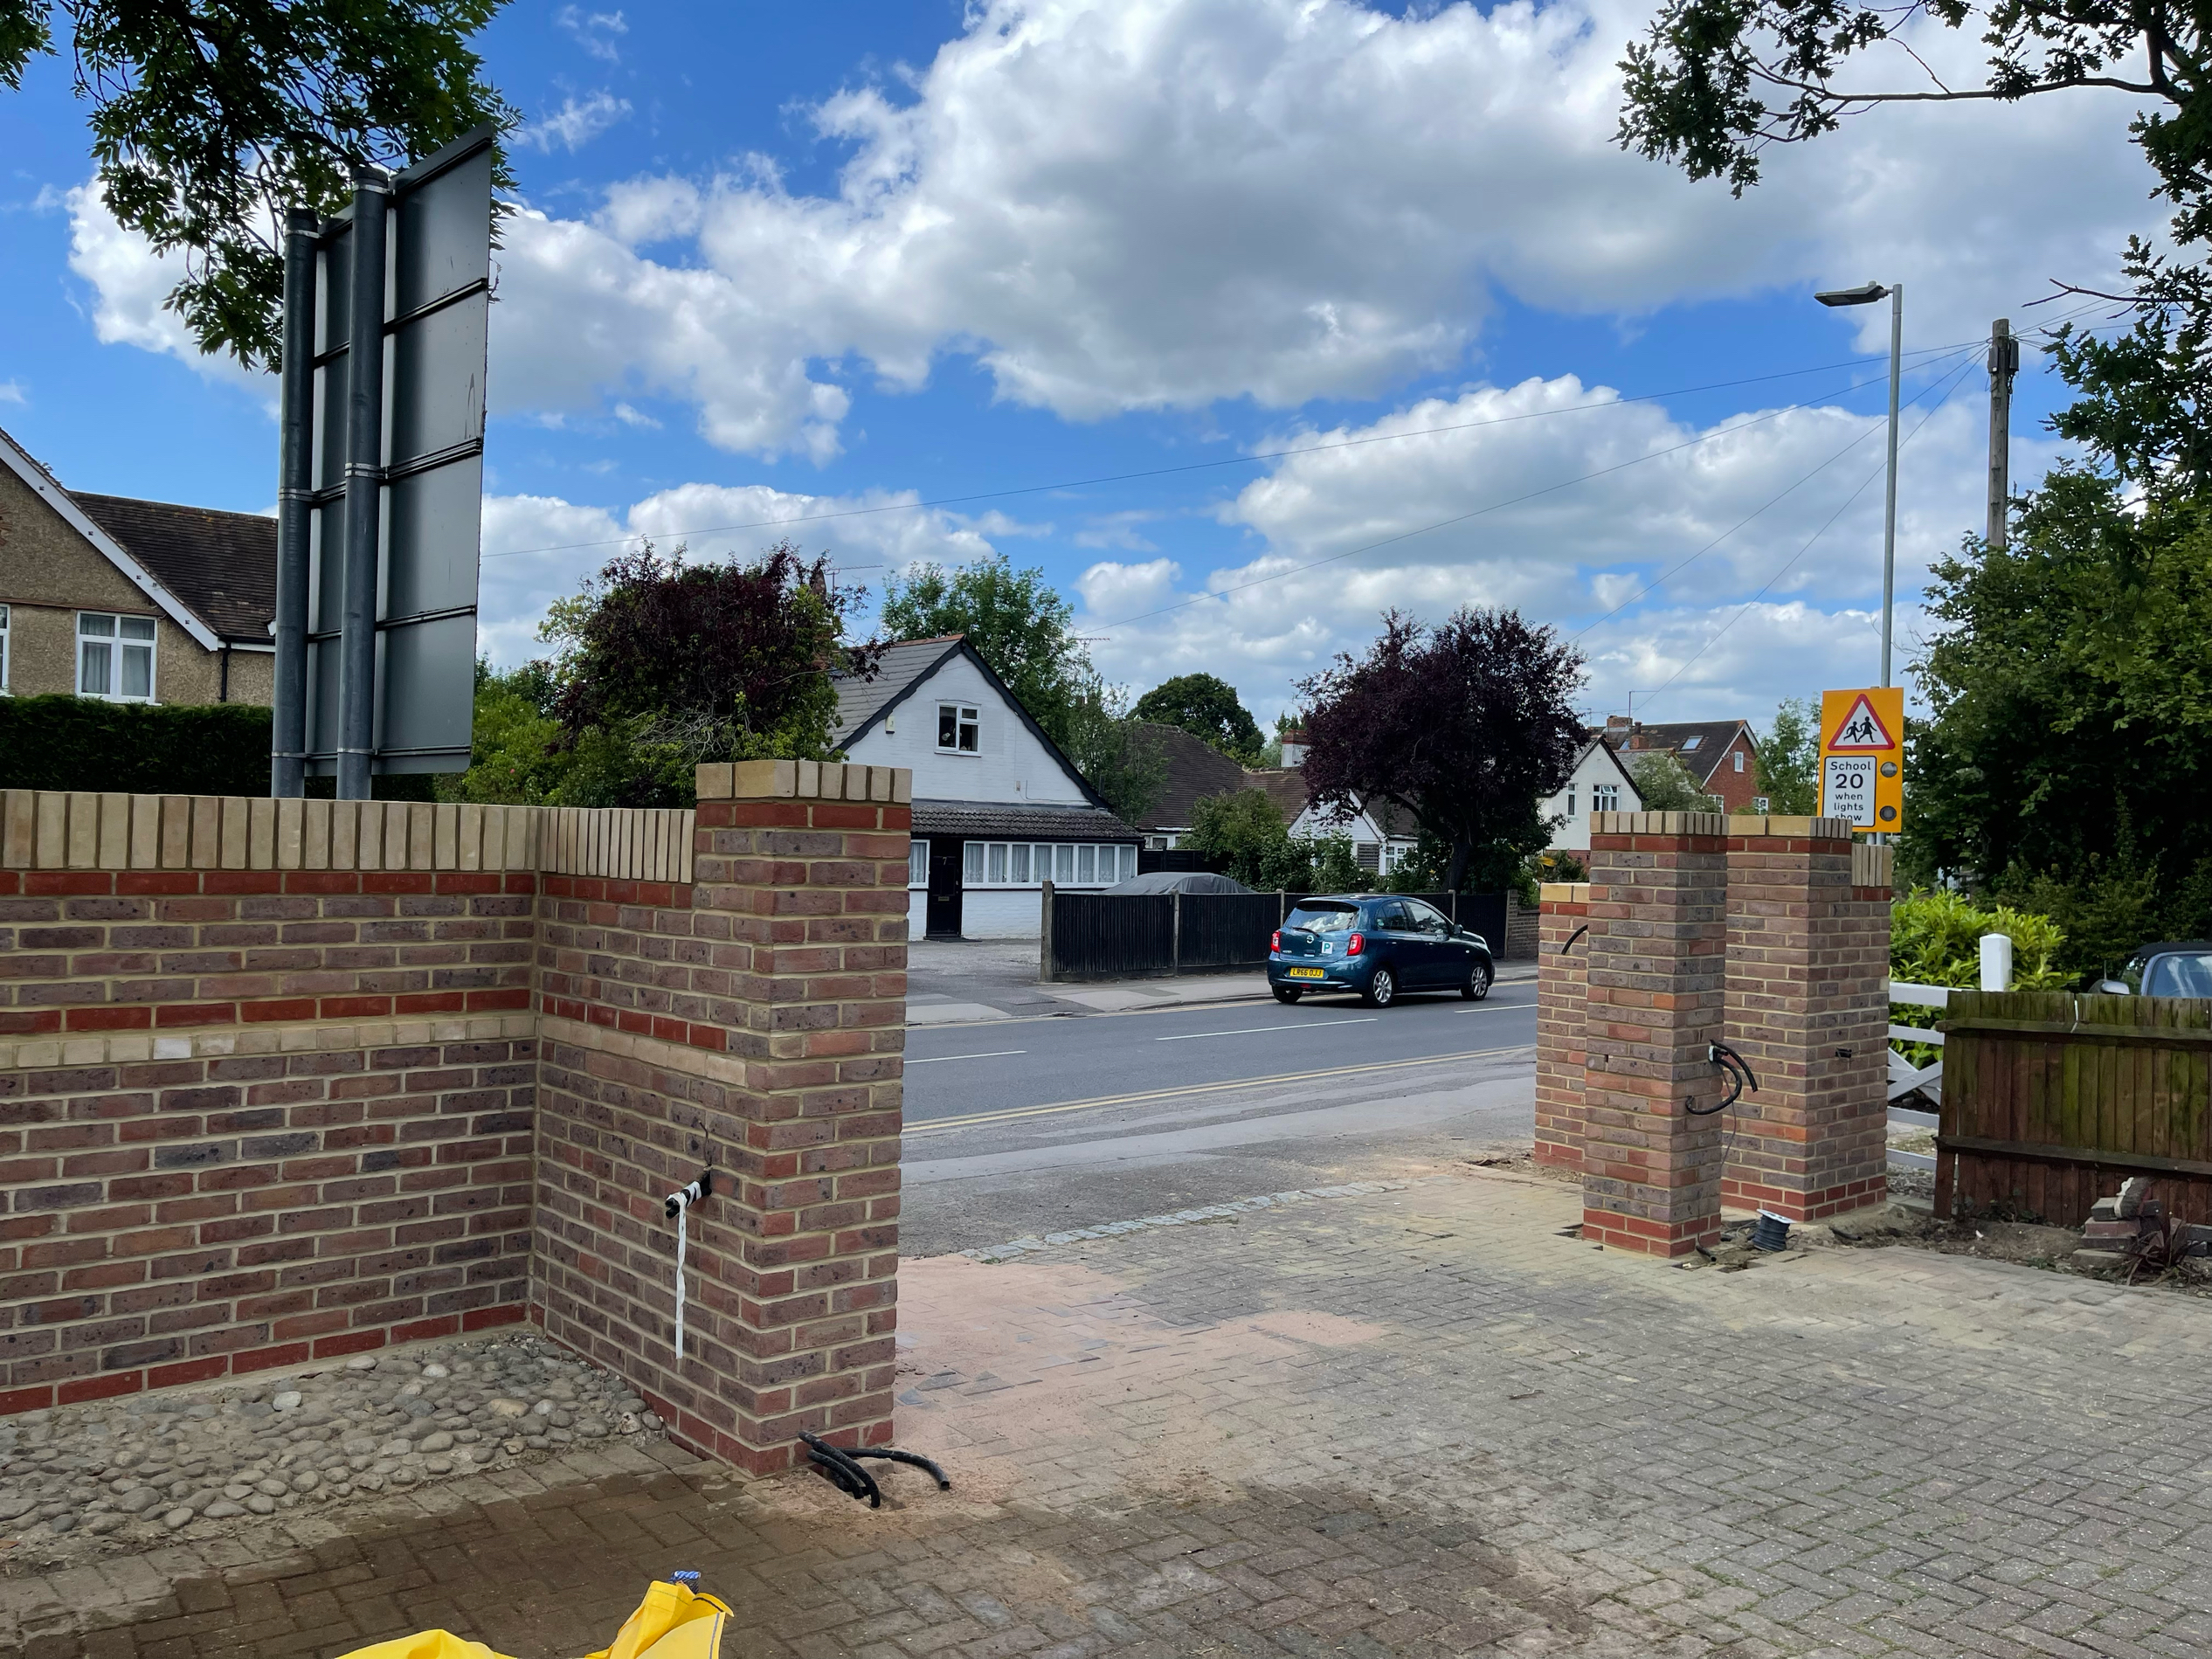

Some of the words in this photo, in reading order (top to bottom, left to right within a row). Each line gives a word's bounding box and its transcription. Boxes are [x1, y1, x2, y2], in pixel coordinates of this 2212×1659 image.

[1830, 761, 1871, 771] School
[1835, 773, 1863, 789] 20
[1834, 802, 1863, 812] lights
[942, 856, 947, 865] 7
[1324, 943, 1331, 952] P
